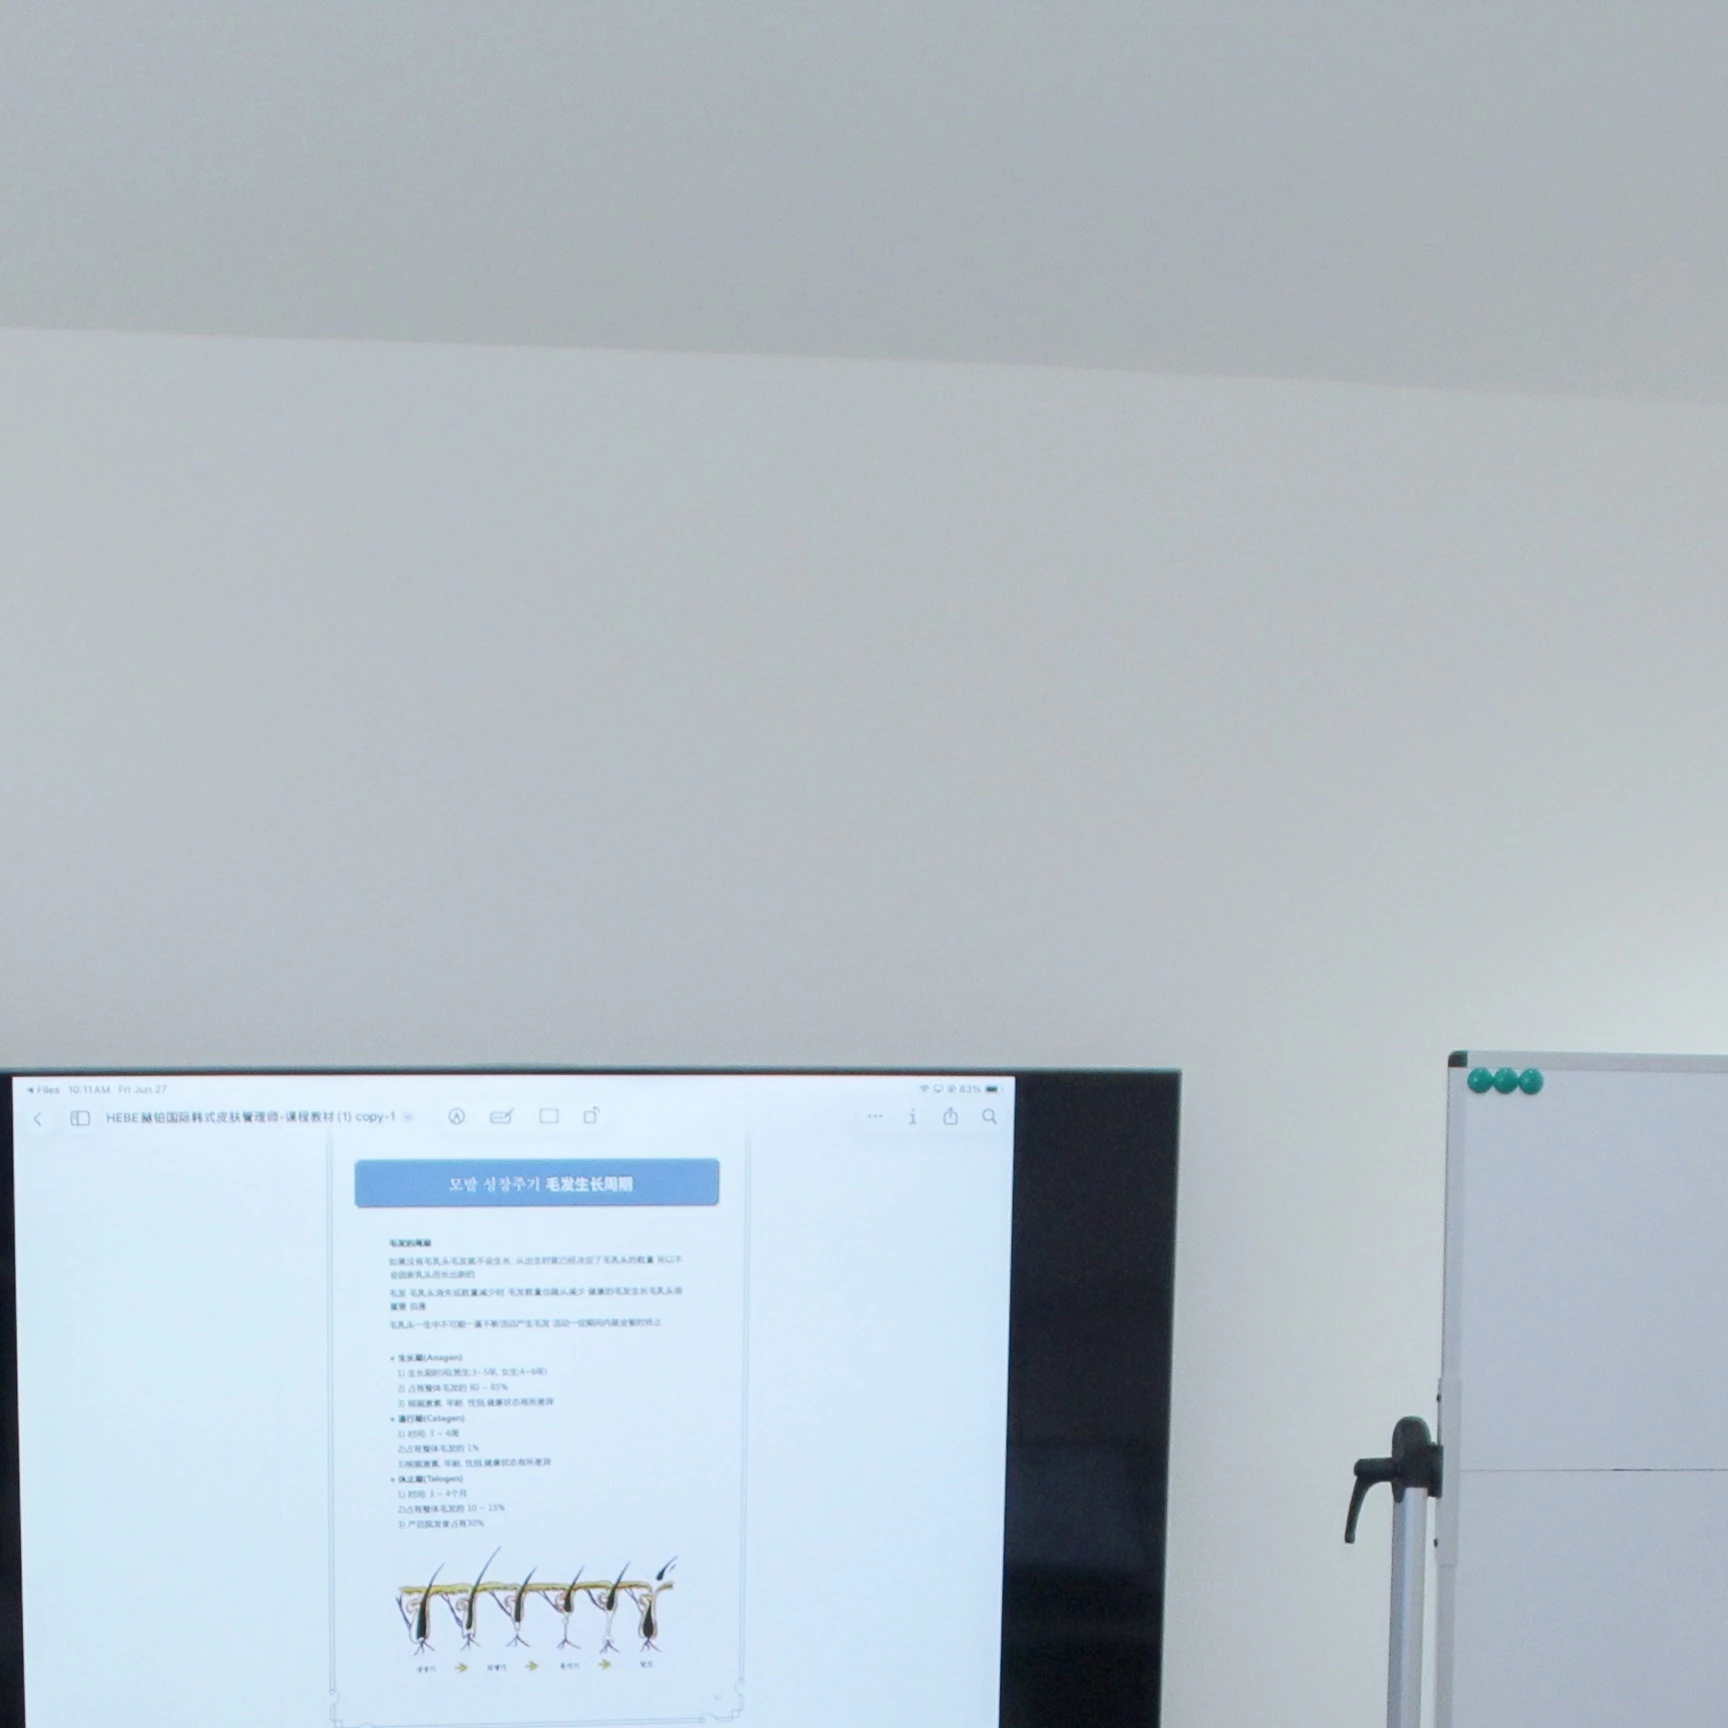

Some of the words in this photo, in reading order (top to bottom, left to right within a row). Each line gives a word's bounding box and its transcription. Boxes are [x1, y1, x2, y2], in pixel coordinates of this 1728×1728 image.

[36, 1085, 60, 1094] Files
[118, 1085, 131, 1094] Fri
[134, 1085, 152, 1094] Jun
[155, 1084, 168, 1094] 27
[355, 1111, 396, 1126] copy-1
[545, 1176, 635, 1192] 毛发生长周期
